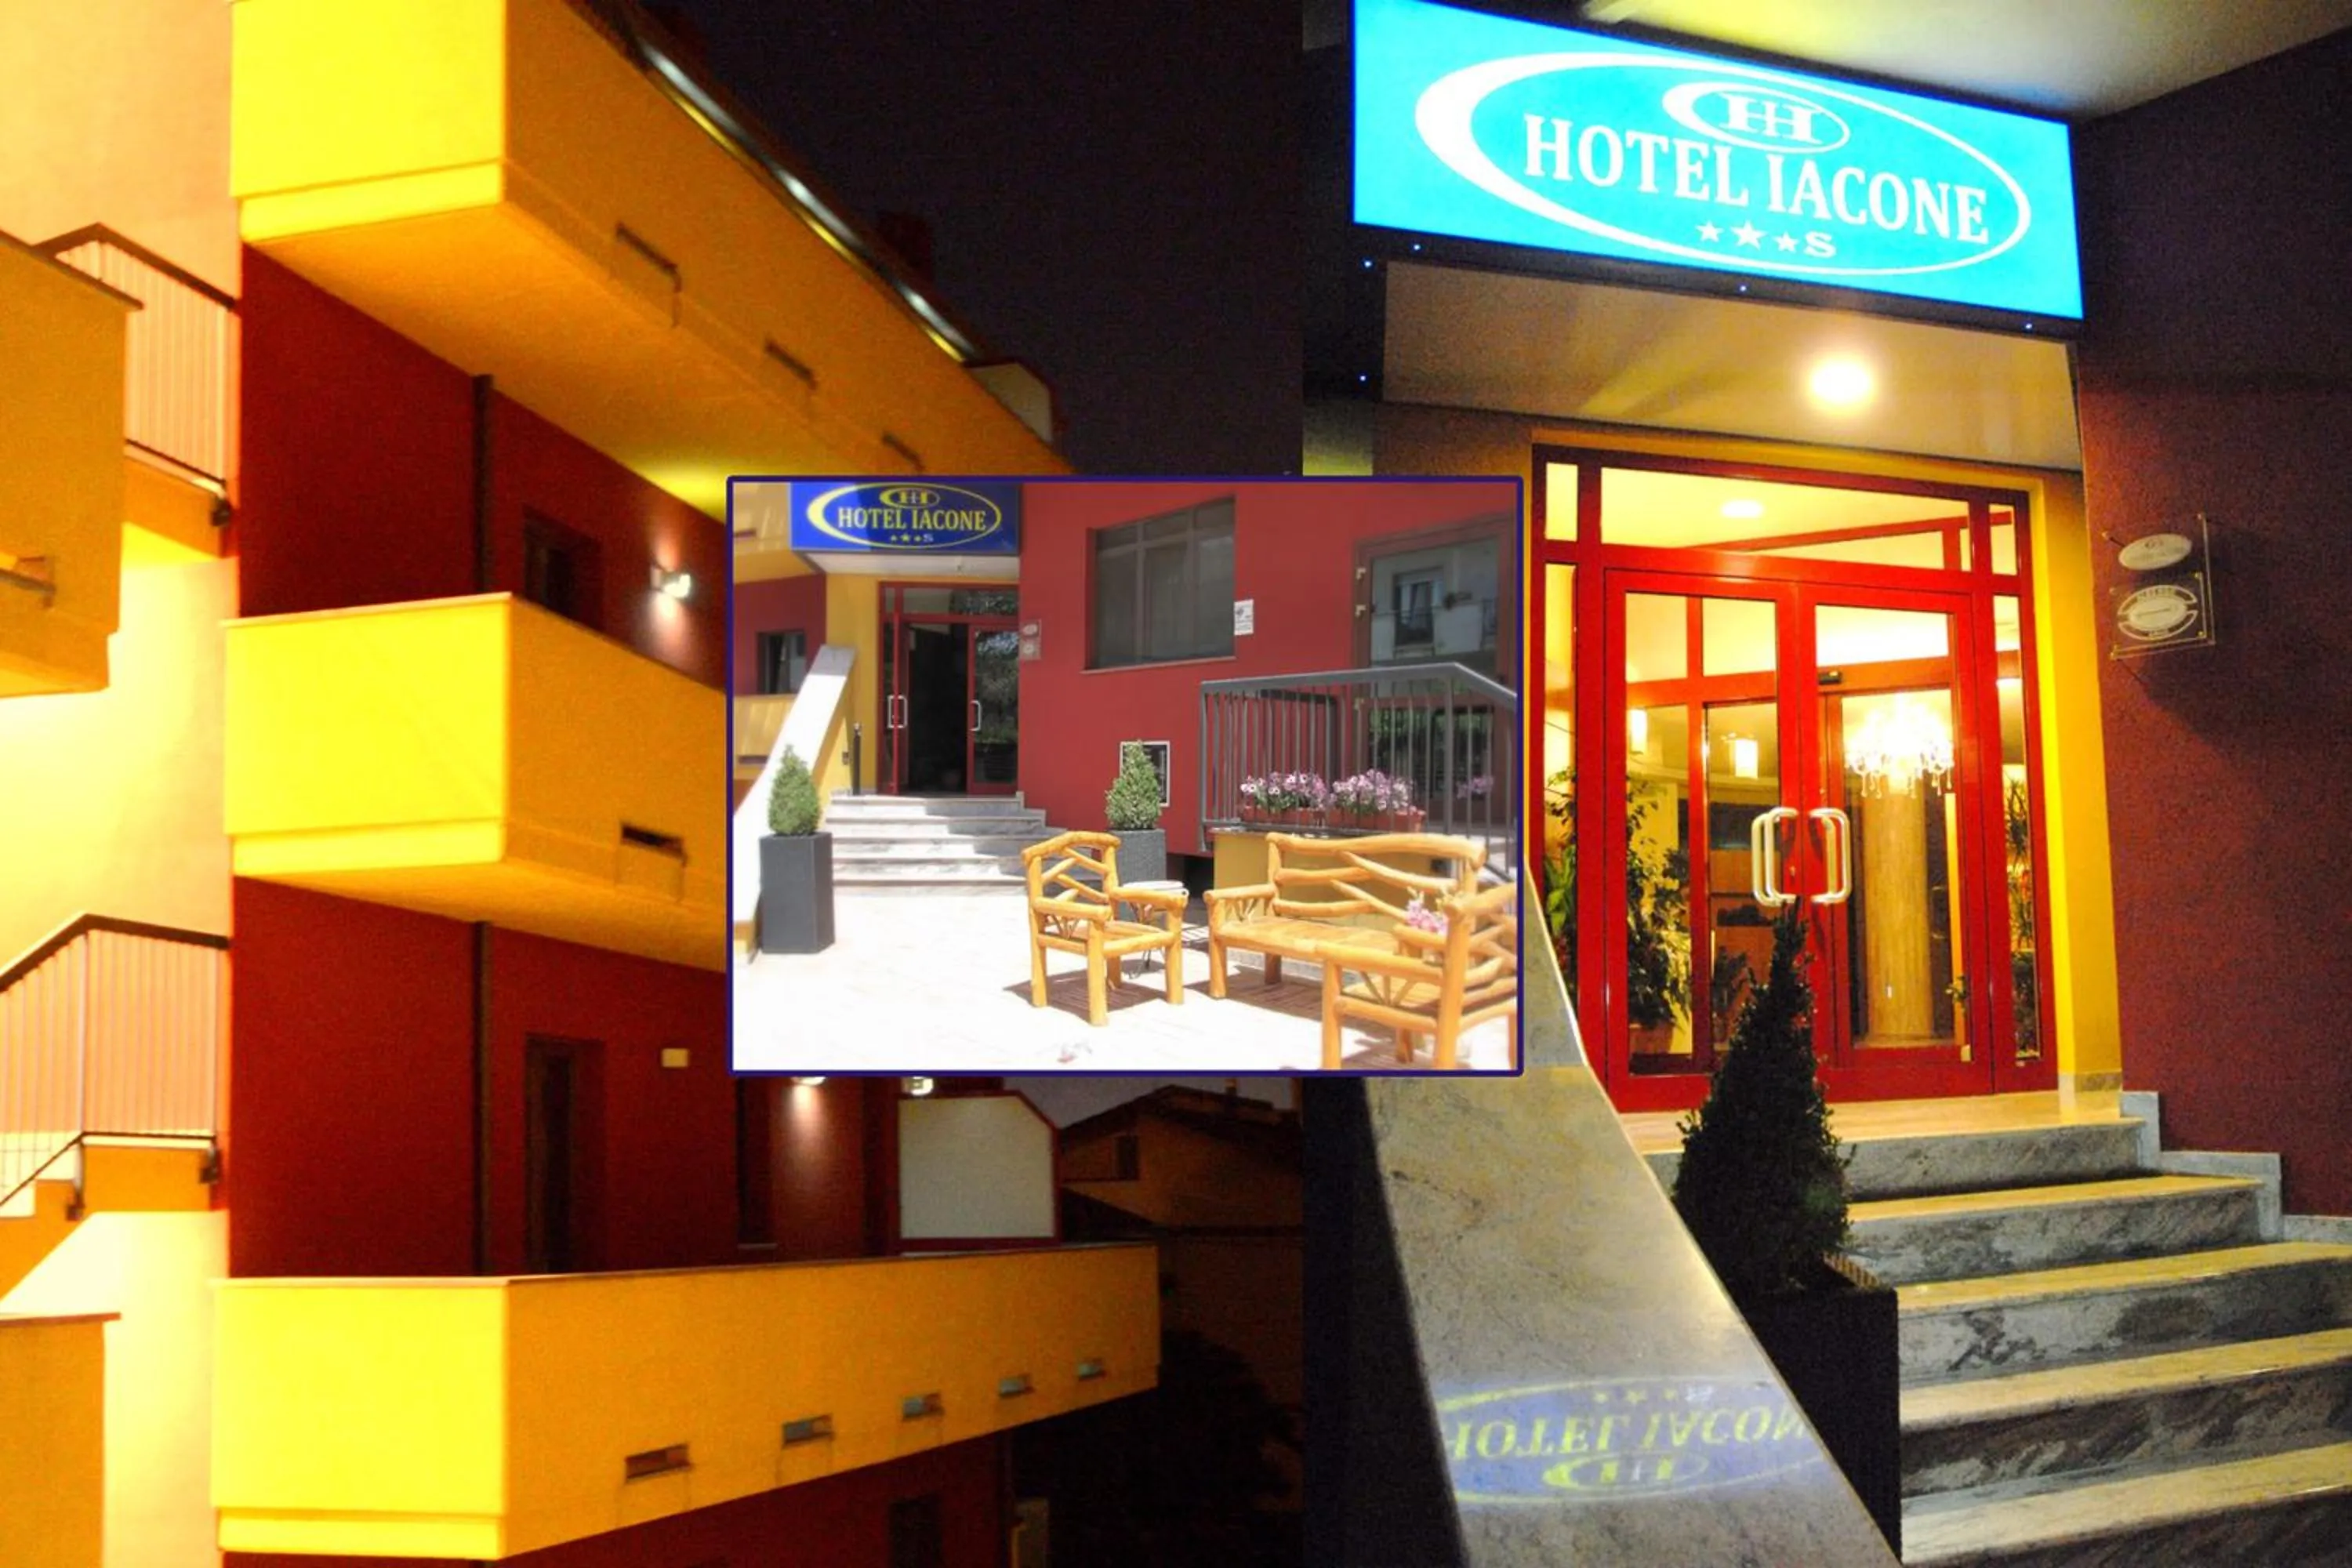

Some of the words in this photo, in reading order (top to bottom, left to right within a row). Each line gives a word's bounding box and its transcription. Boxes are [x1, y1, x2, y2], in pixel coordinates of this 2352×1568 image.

[1524, 114, 1748, 207] HOTEL
[1766, 154, 1989, 243] IACONE
[837, 507, 907, 529] HOTEL
[912, 510, 986, 531] IACONE
